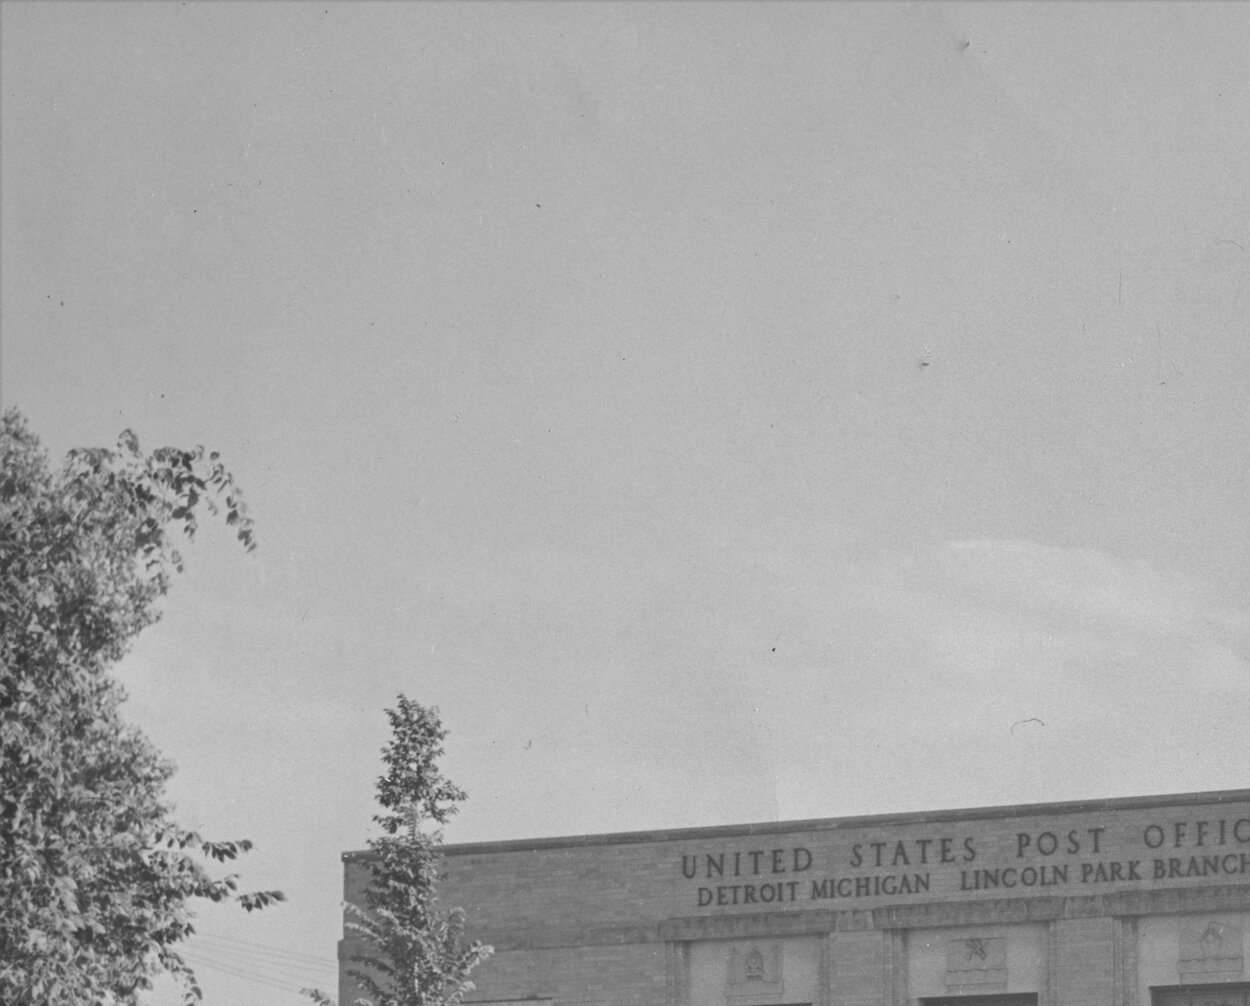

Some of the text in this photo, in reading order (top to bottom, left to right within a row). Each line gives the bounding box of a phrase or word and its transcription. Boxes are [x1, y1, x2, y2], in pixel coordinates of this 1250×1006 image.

[682, 847, 814, 880] UNITED
[850, 837, 978, 868] STATES
[1016, 828, 1106, 858] POST
[697, 881, 800, 907] DETROIT
[811, 873, 931, 900] MICHIGAN
[960, 864, 1069, 891] LINCOLN
[1081, 860, 1143, 884] PARK
